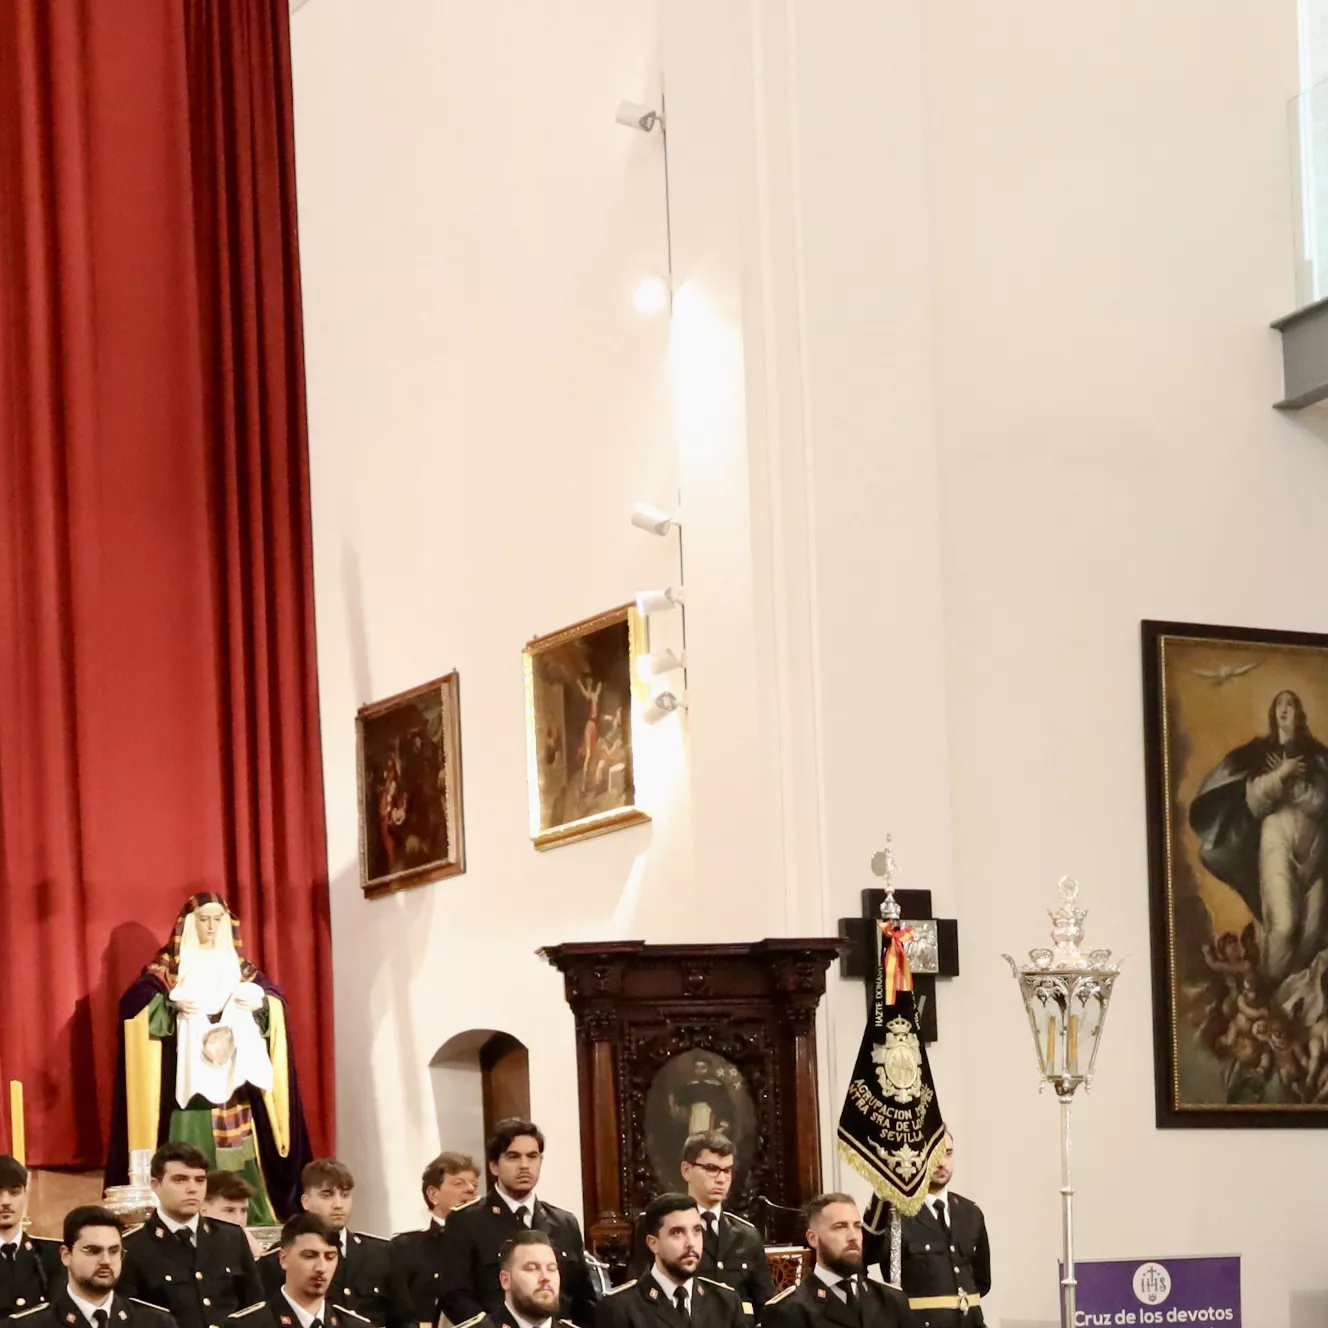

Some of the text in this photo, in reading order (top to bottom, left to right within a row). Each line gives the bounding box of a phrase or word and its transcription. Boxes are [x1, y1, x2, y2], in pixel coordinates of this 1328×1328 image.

[875, 1002, 884, 1027] HAZTE
[854, 1079, 912, 1120] AGRUPACION
[870, 1112, 890, 1129] SRA
[896, 1121, 910, 1132] DE
[1075, 1306, 1234, 1327] Cruz de los devotos
